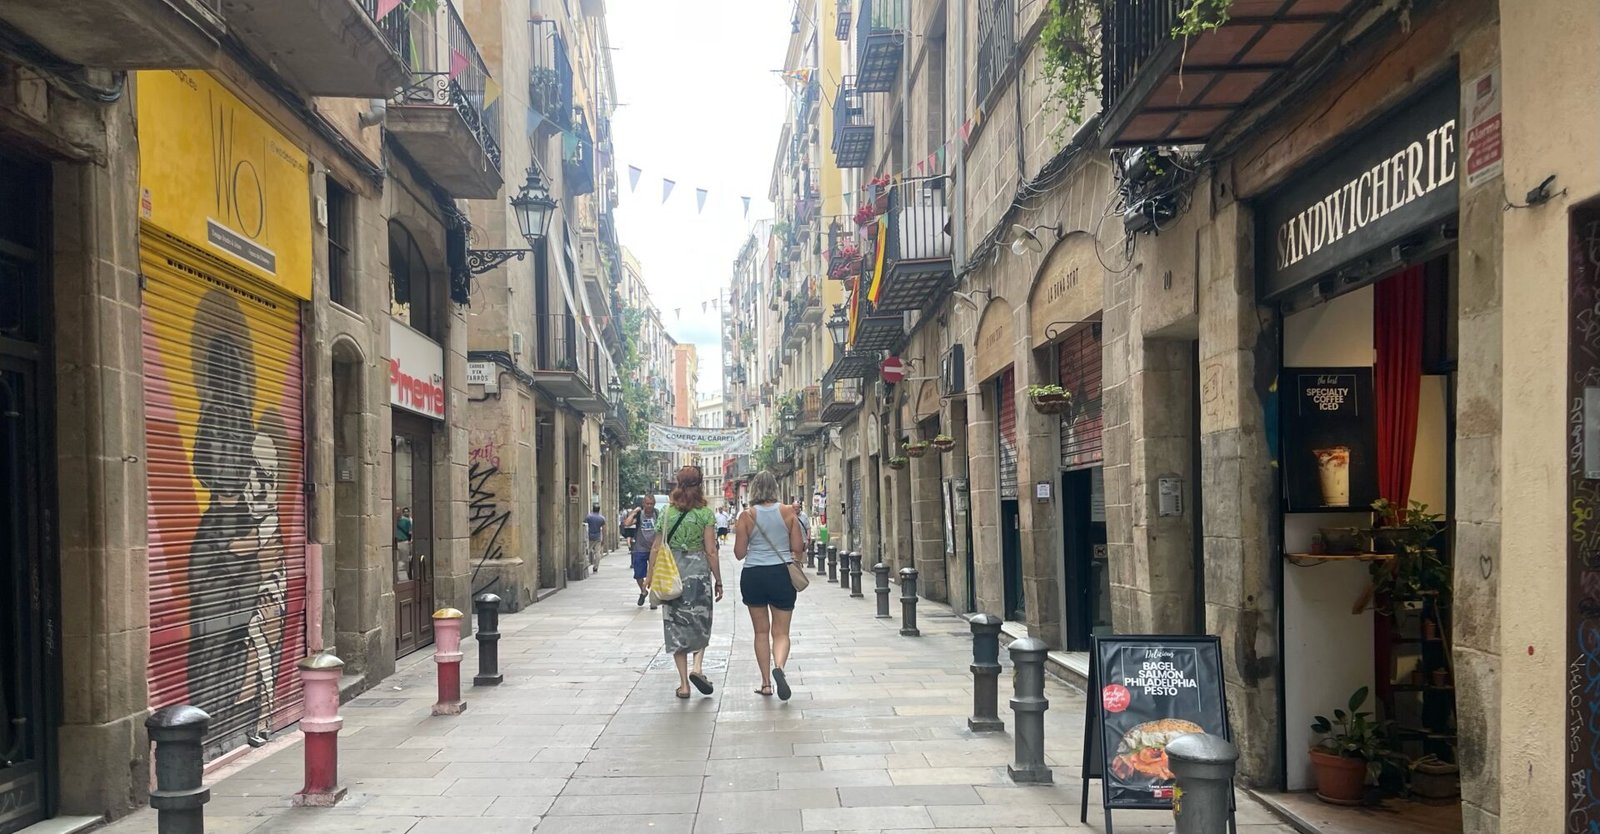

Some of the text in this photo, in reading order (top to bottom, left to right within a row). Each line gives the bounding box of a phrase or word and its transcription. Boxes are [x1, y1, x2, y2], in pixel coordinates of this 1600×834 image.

[1277, 119, 1456, 271] SANDWICHERIE
[1306, 388, 1349, 396] SPECIALTY
[1319, 403, 1339, 411] ICED
[1145, 649, 1175, 659] Delicious
[1142, 662, 1176, 671] BAGEL
[1138, 670, 1183, 679] SALMON
[1124, 678, 1197, 688] PHILADELPHIA
[1144, 686, 1178, 696] PESTO
